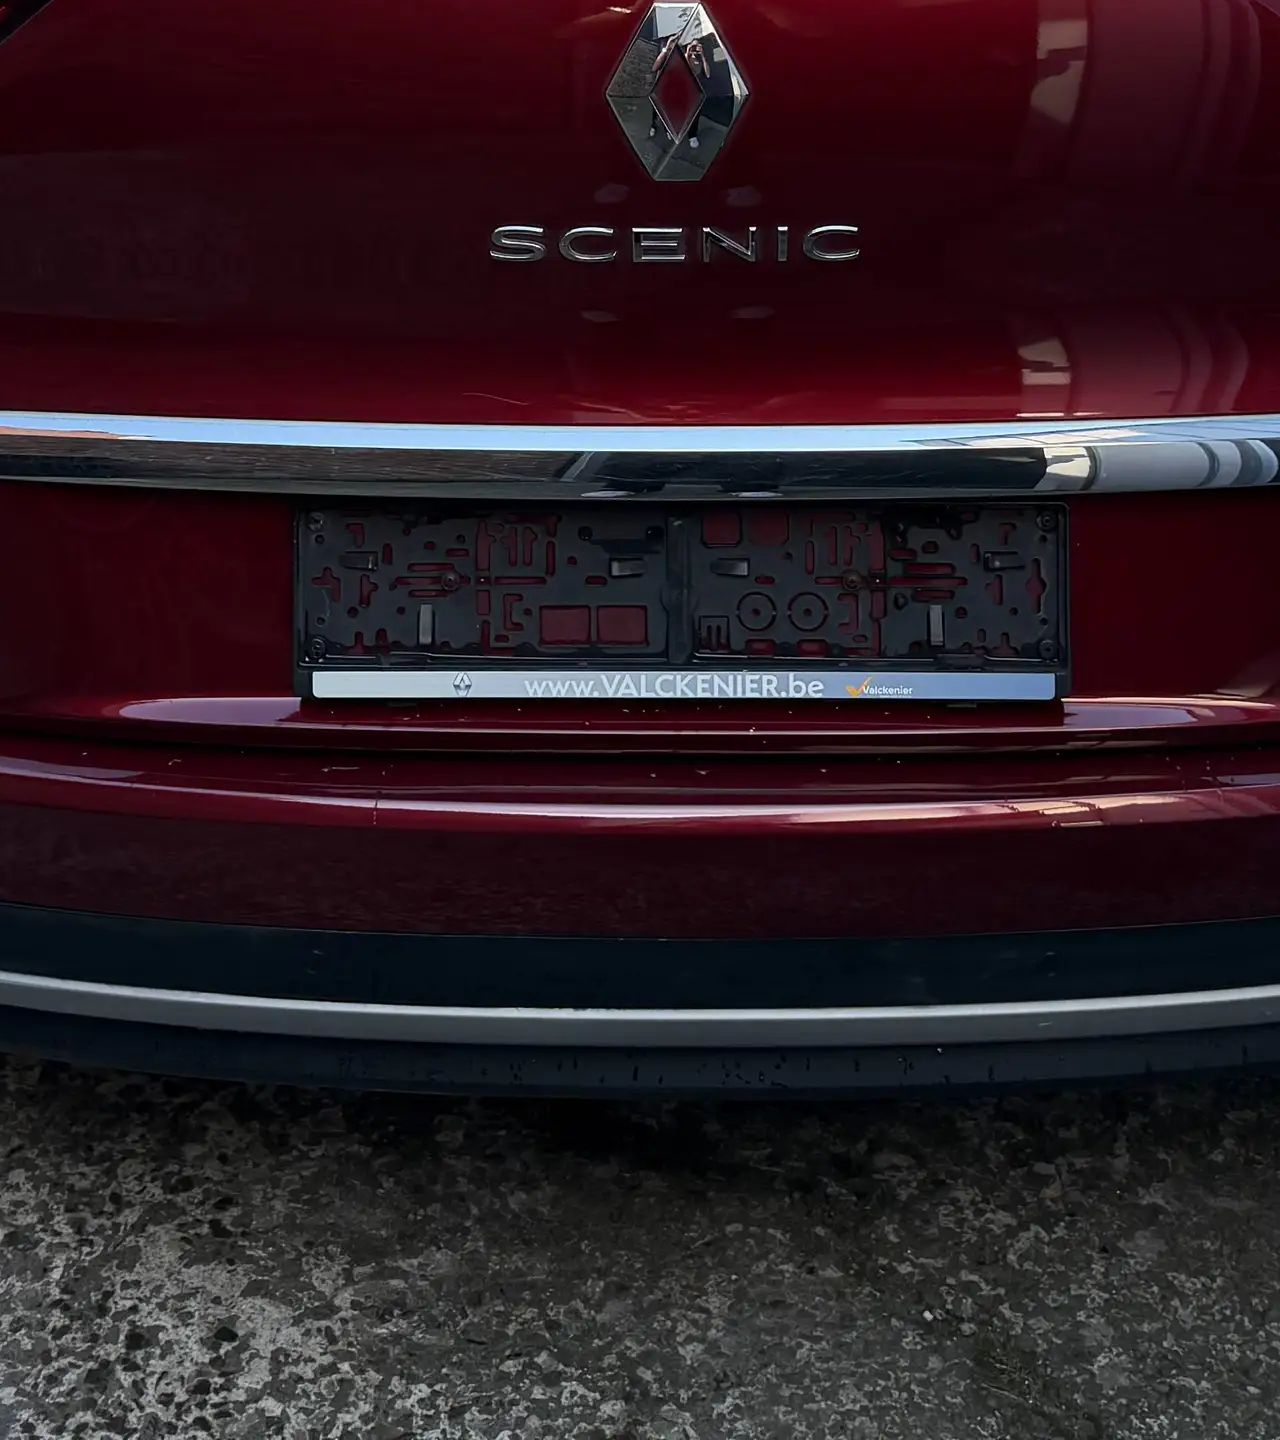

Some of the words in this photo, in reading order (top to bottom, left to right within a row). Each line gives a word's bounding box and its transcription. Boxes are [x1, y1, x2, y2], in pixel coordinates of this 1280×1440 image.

[489, 225, 861, 262] SCENIC
[524, 674, 825, 698] www.VALCKENIER.be
[863, 685, 913, 695] Valckenier
